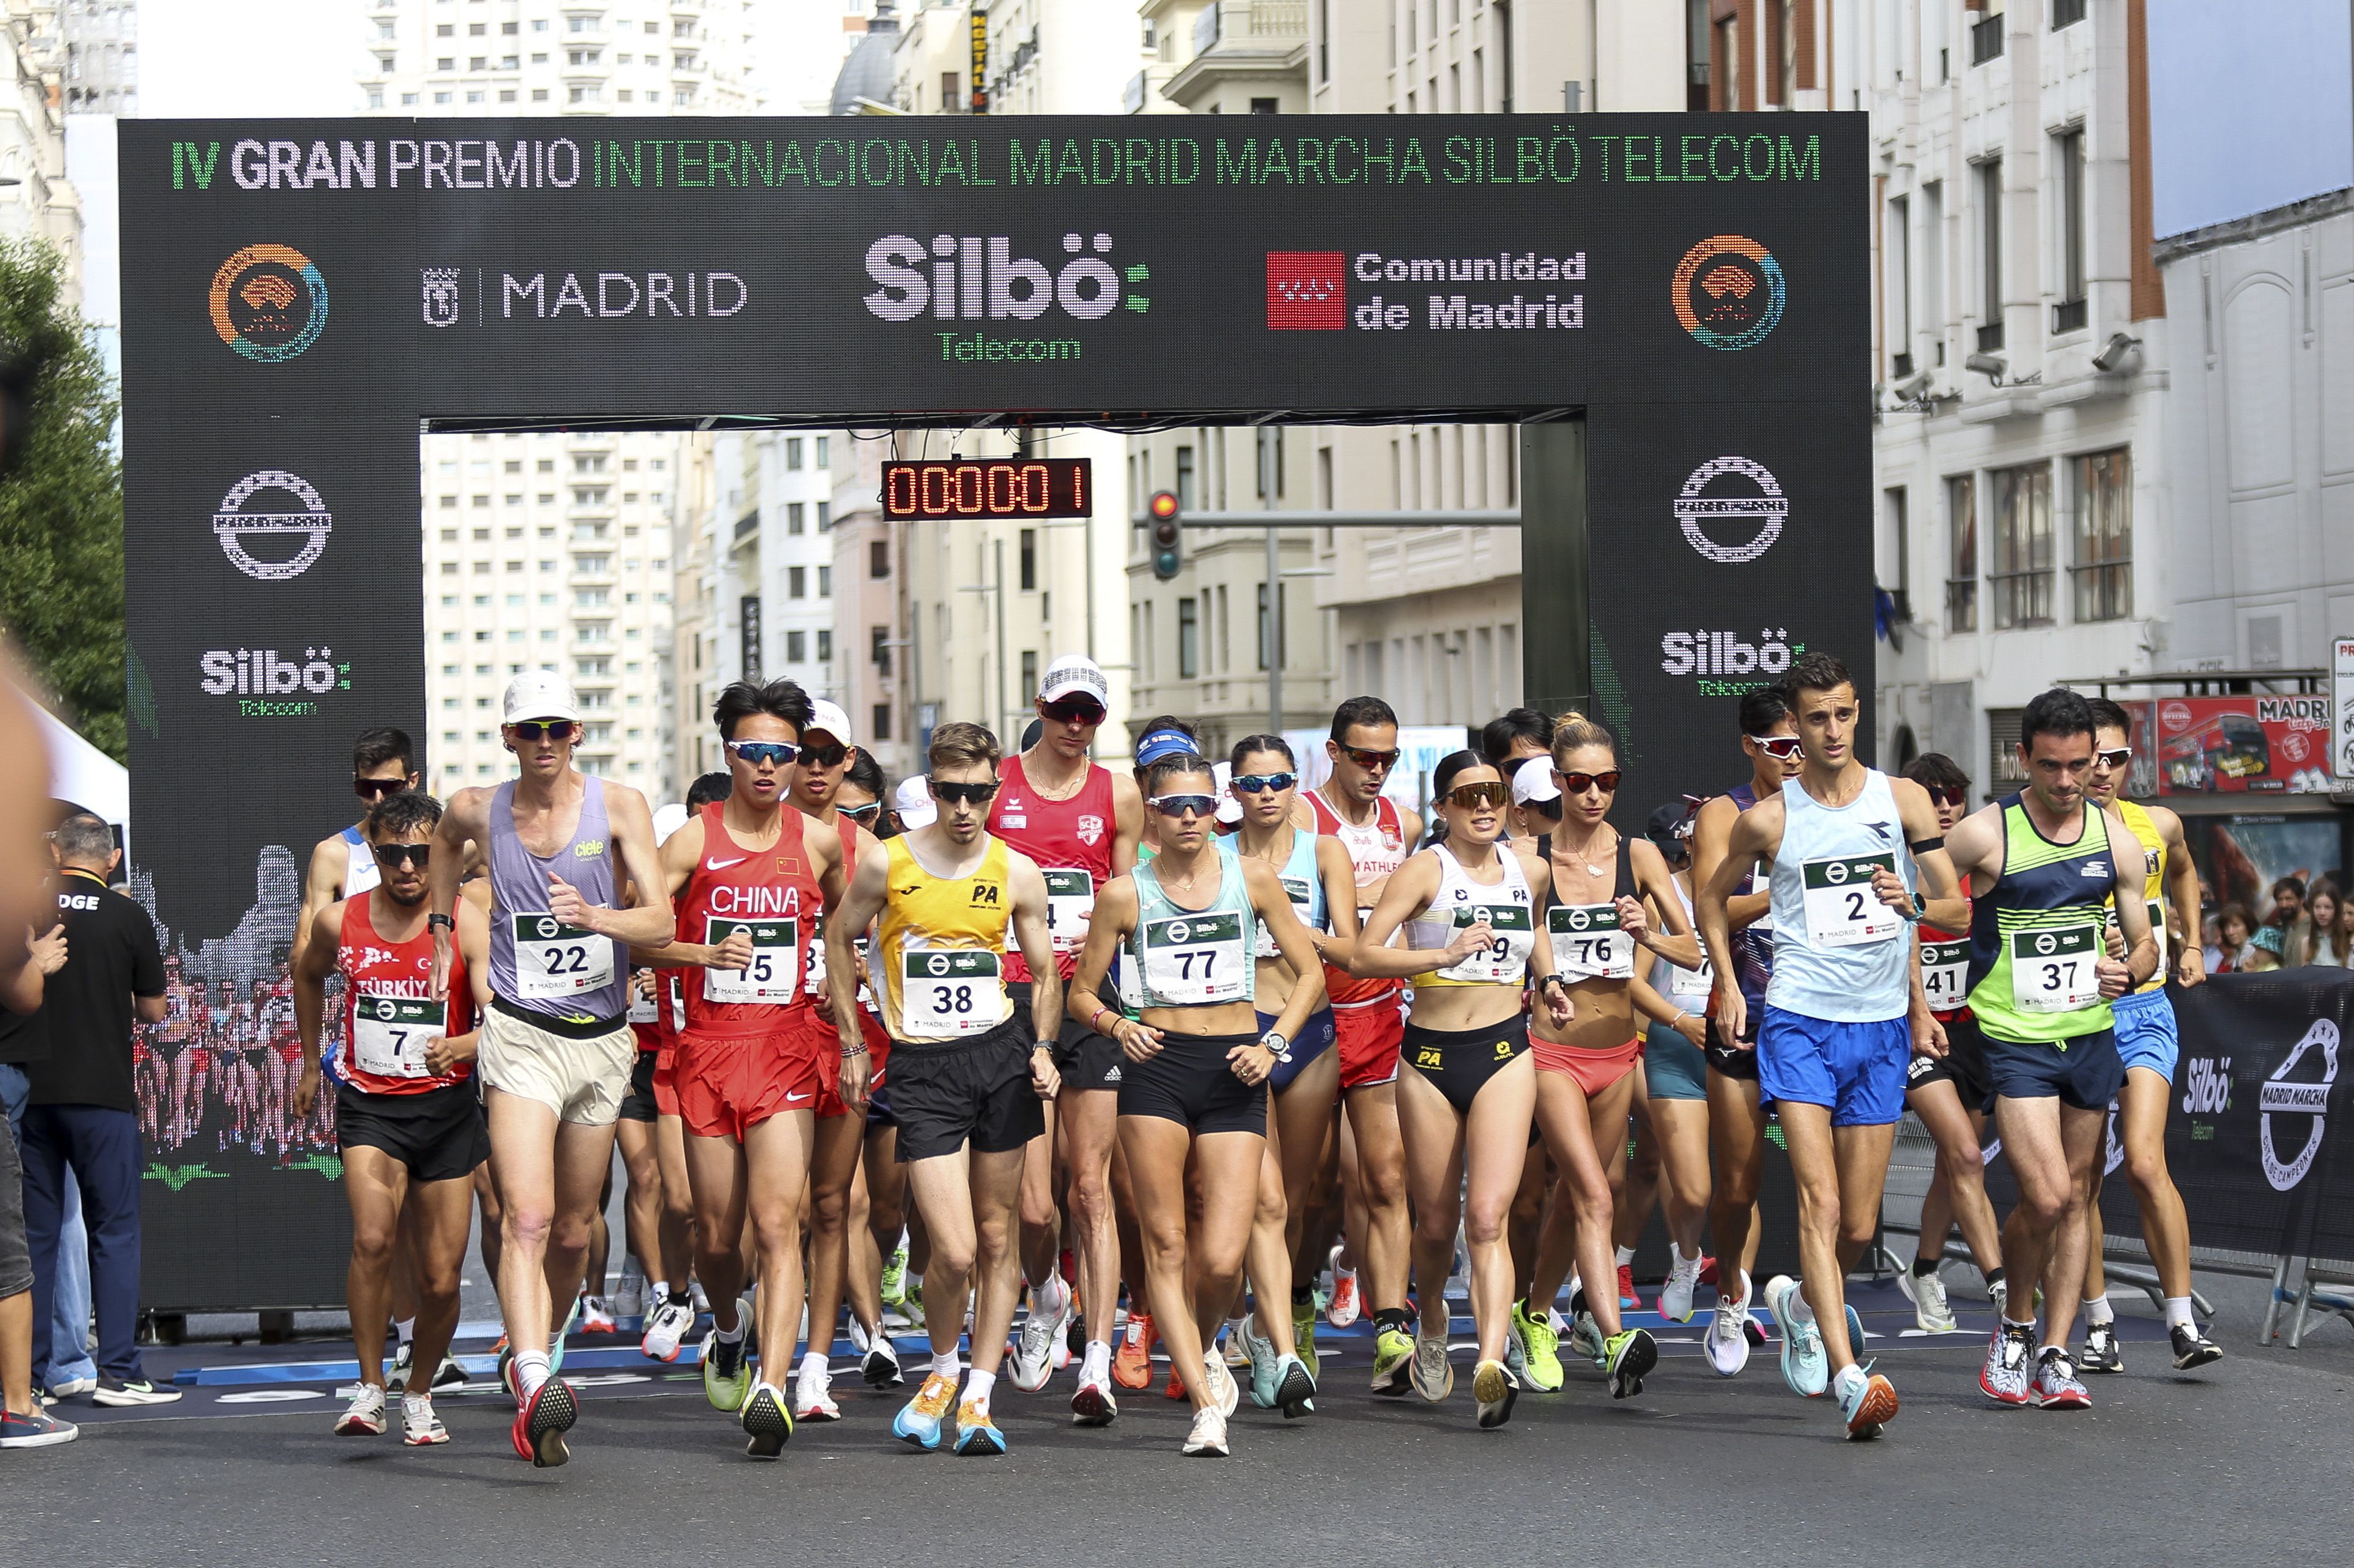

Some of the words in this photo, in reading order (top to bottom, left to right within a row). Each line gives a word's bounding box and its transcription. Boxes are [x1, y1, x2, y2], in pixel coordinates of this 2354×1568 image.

[172, 141, 220, 190] IV
[231, 138, 376, 190] GRAN
[389, 137, 581, 189] PREMIO
[593, 137, 997, 189] INTERNACIONAL
[1009, 137, 1200, 186] MADRID
[1215, 136, 1432, 185] MARCHA
[1443, 125, 1582, 184] SILBÖ
[1590, 133, 1822, 182] TELECOM
[862, 232, 1121, 322] Silbö
[1354, 252, 1587, 282] Comunidad
[502, 272, 748, 318] MADRID
[1354, 296, 1410, 331] de
[1428, 295, 1585, 330] Madrid
[933, 332, 1082, 363] Telecom
[1661, 627, 1790, 676] Silbö
[200, 646, 336, 695] Silbö
[1080, 821, 1090, 829] SC
[575, 839, 603, 857] ciele
[710, 886, 799, 914] CHINA
[972, 885, 998, 904] PA
[1512, 890, 1528, 902] PA
[1845, 892, 1867, 922] 2
[1196, 922, 1218, 932] Silbö
[1595, 913, 1616, 922] Silbö
[757, 927, 778, 938] Silbö
[1827, 929, 1857, 938] MADRID
[545, 946, 588, 975] 22
[1574, 938, 1612, 964] 76
[1174, 950, 1217, 980] 77
[1458, 965, 1485, 976] MADRID
[2042, 961, 2078, 991] 37
[721, 987, 749, 995] MADRID
[1167, 987, 1197, 997] MADRID
[1925, 970, 1957, 994] 41
[932, 985, 973, 1014] 38
[2034, 998, 2062, 1006] MADRID
[389, 1031, 408, 1056] 7
[369, 1060, 395, 1069] MADRID
[1417, 1051, 1441, 1066] PA
[2183, 1057, 2231, 1114] Silbö
[2261, 1086, 2291, 1105] MADRID
[2291, 1087, 2326, 1107] MARCHA
[2269, 1163, 2277, 1179] DE
[2277, 1137, 2318, 1184] CAMPEONES
